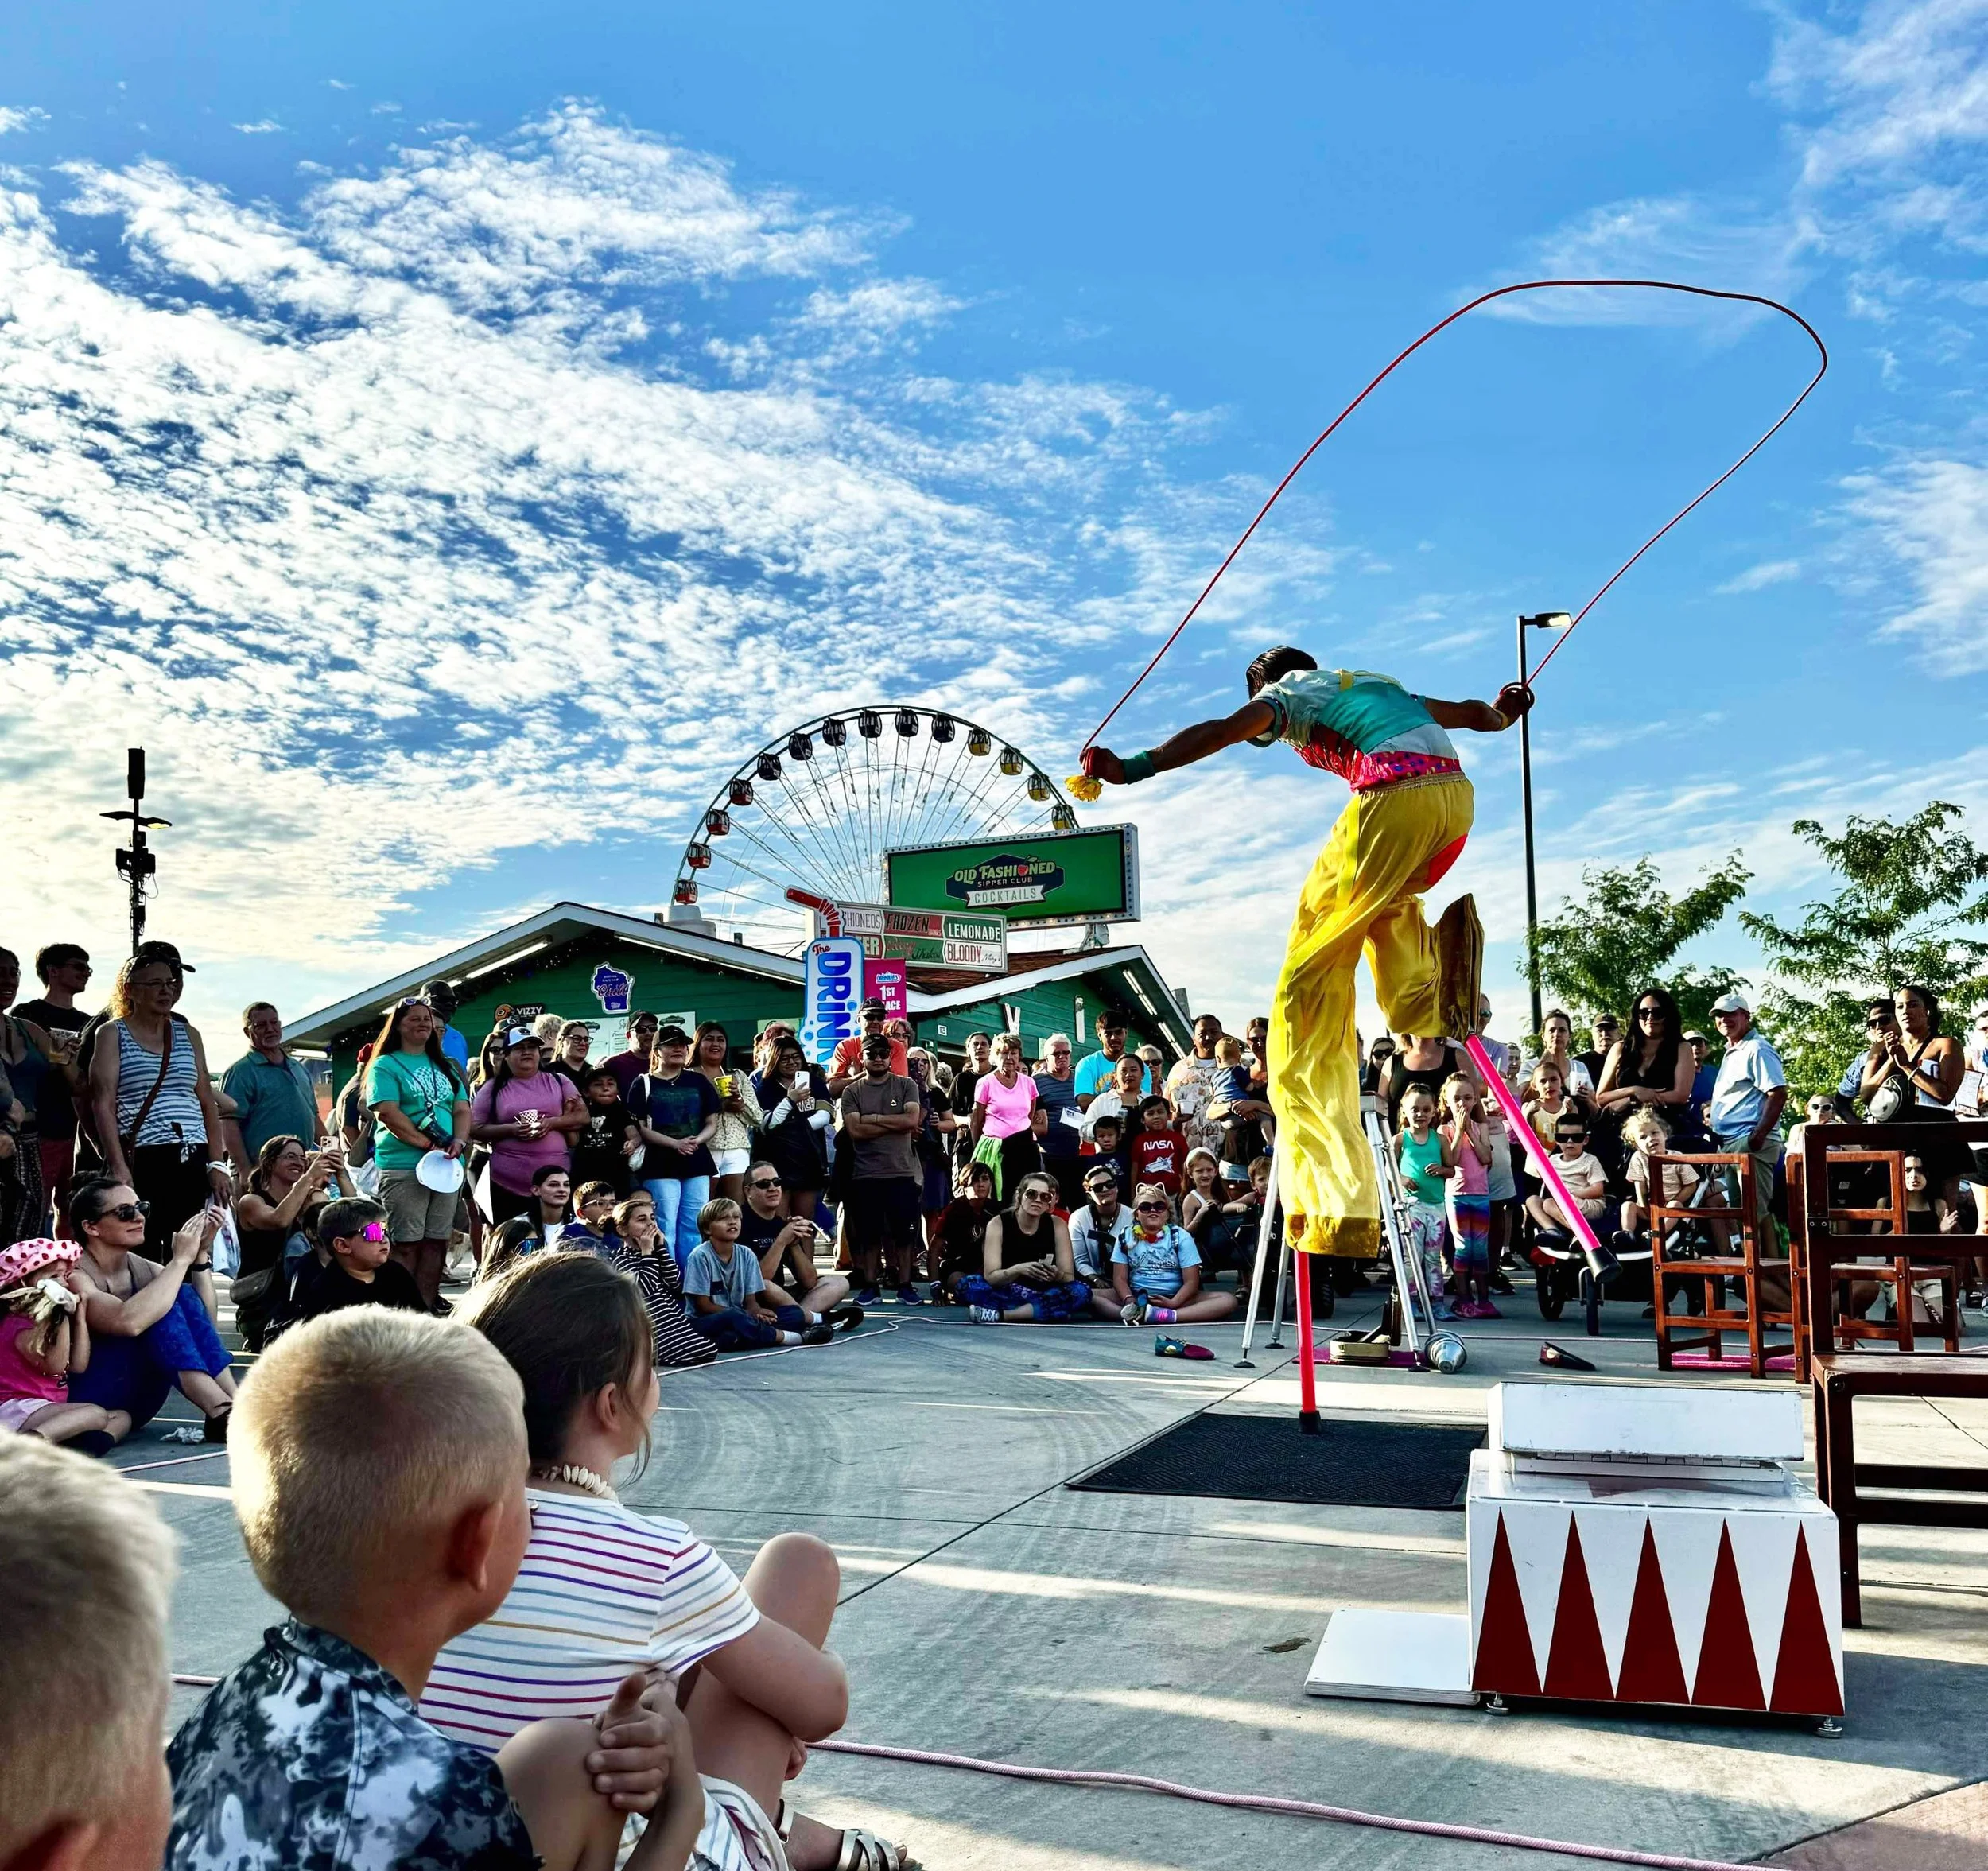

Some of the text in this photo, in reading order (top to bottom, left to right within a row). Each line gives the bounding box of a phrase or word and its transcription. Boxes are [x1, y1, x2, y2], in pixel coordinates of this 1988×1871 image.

[954, 868, 977, 884] OLD
[977, 879, 1008, 887] SIPPER
[974, 887, 1037, 904] COCKTAILS
[843, 911, 881, 929] HIONEDS
[886, 914, 930, 933] FROZEN
[948, 922, 1000, 941] LEMONADE
[812, 943, 831, 956] The
[947, 943, 982, 963] BLOODY
[879, 985, 896, 1000] 1ST
[517, 1006, 542, 1015] VIZZY
[883, 1000, 901, 1011] ACE
[1143, 1139, 1175, 1151] NASA
